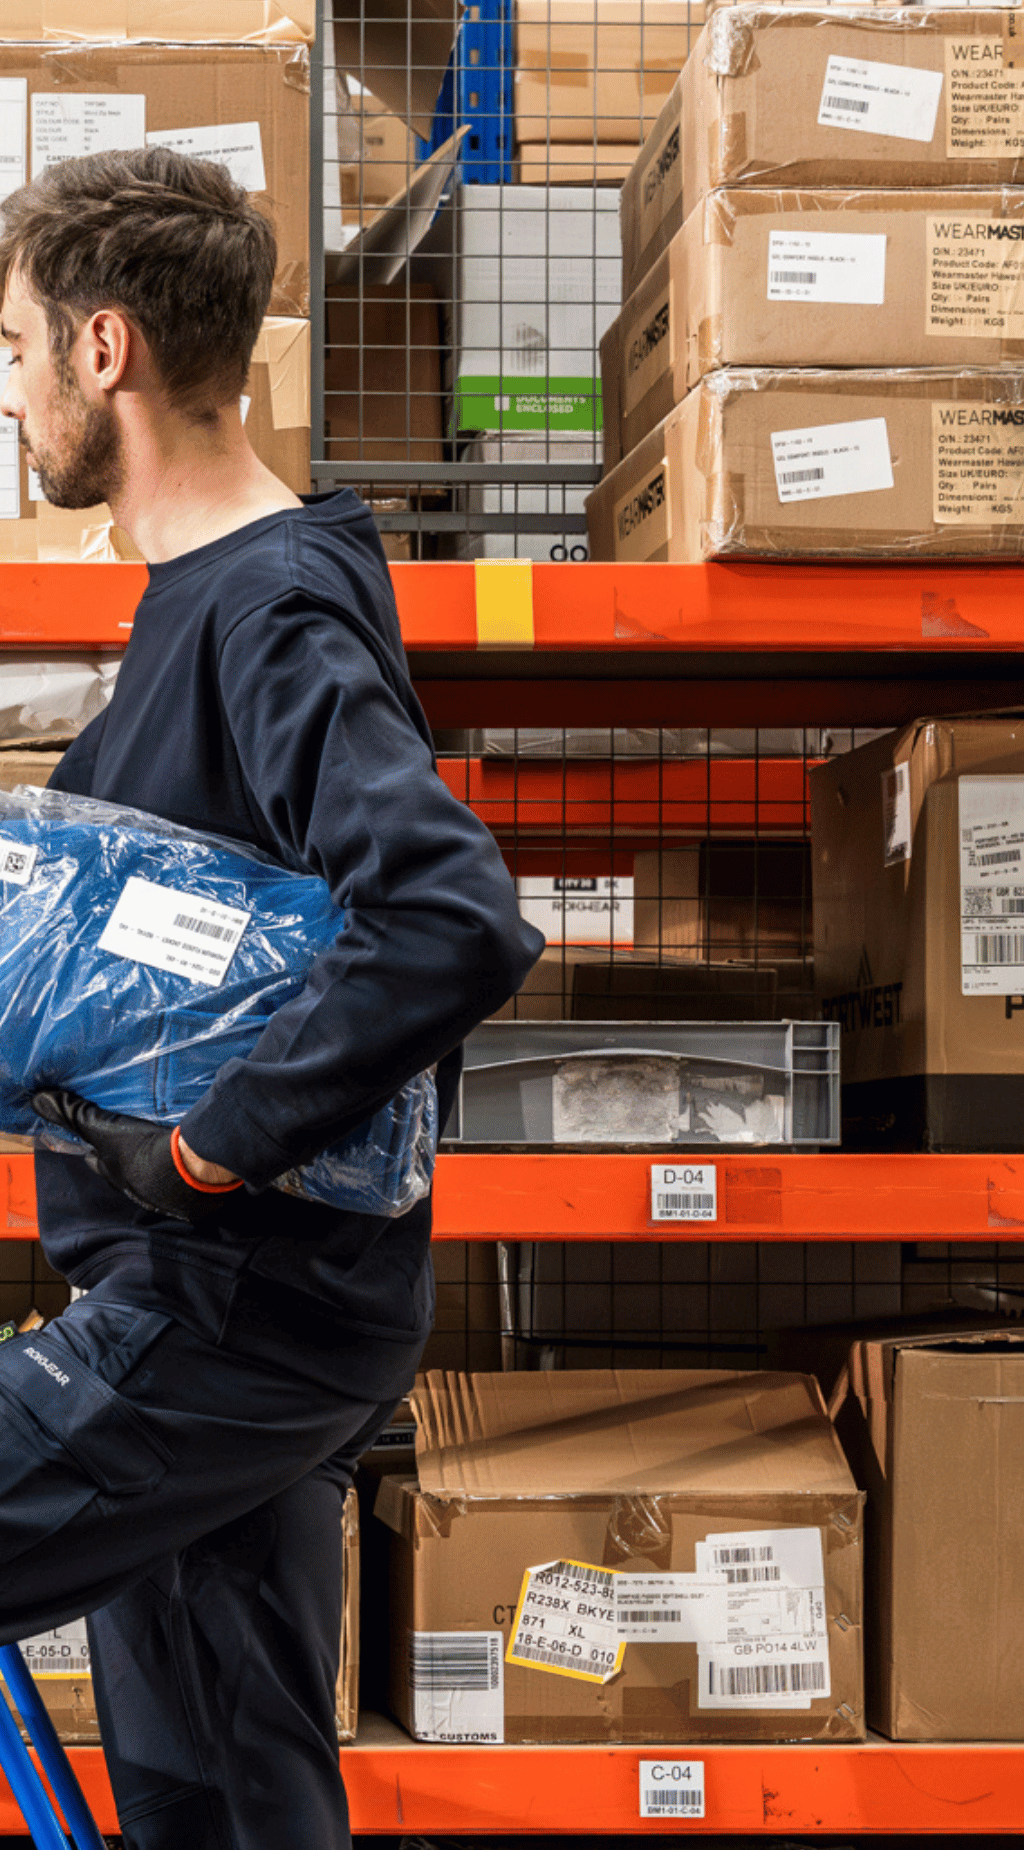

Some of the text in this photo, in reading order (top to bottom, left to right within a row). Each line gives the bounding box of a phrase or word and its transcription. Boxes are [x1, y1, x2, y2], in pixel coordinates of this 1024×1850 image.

[516, 404, 574, 413] ENCLOSED
[664, 1169, 703, 1184] D-04
[527, 1591, 571, 1612] R238X
[522, 1614, 586, 1639] 871 XL
[517, 1632, 615, 1664] 18-E-06-D 010
[440, 1732, 498, 1740] CUSTOMS
[651, 1765, 692, 1781] C-04
